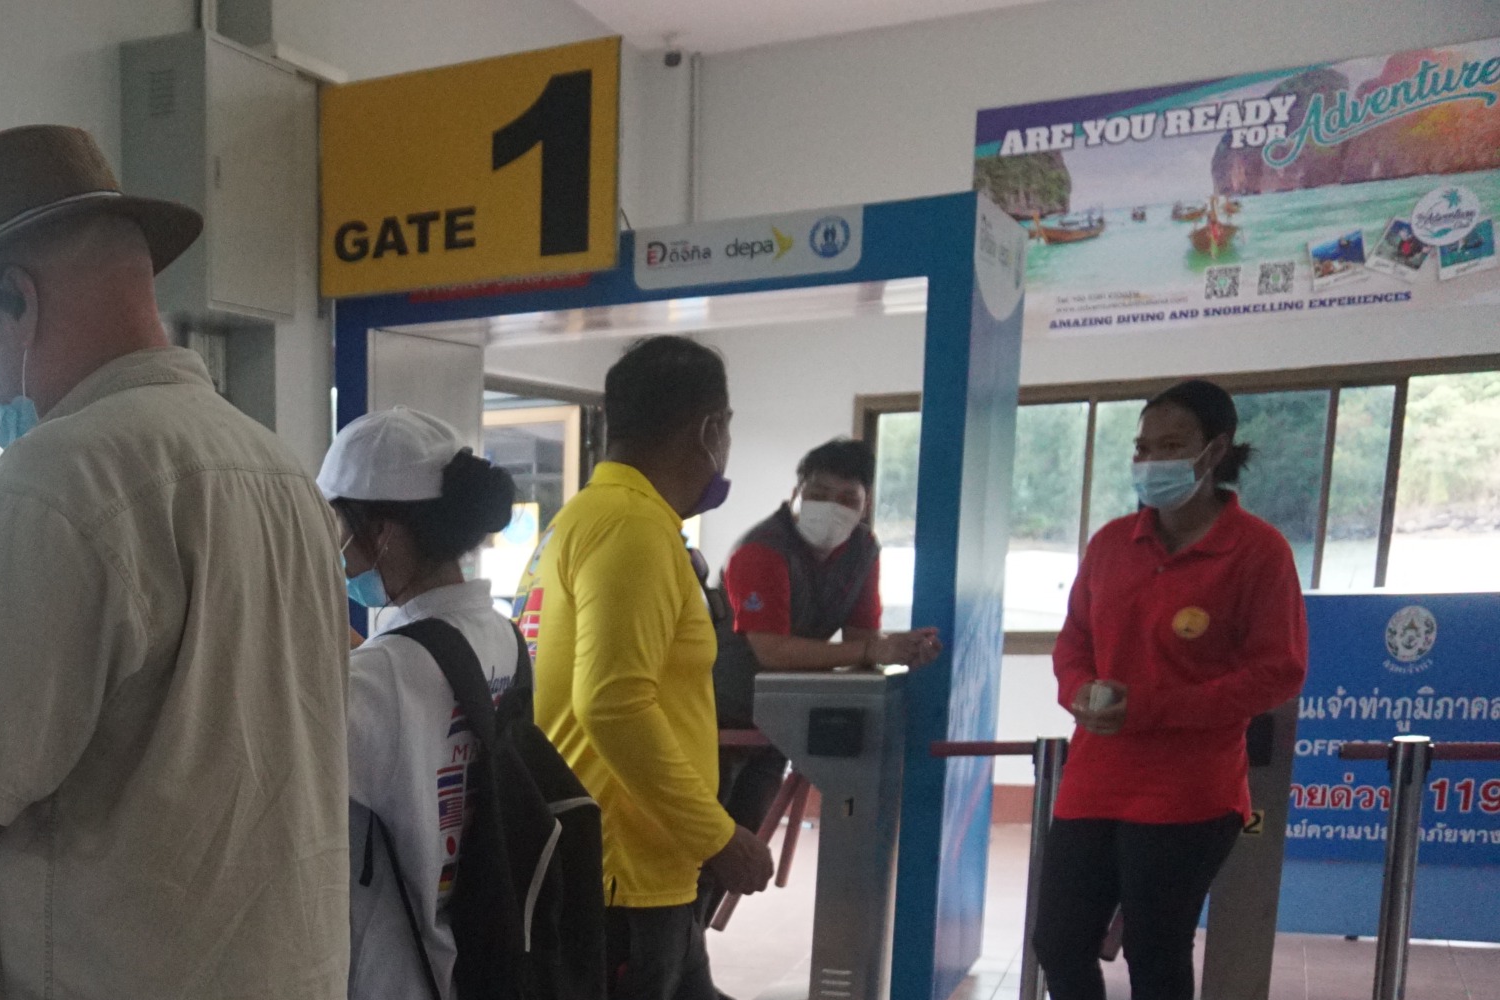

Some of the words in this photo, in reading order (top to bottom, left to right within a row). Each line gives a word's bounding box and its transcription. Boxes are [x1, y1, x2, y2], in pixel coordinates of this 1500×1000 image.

[1000, 123, 1075, 154] ARE
[1082, 114, 1156, 146] YOU
[1164, 95, 1297, 136] READY
[1263, 56, 1500, 168] Adventure
[1230, 124, 1287, 149] FOR
[492, 69, 591, 256] 1
[334, 206, 476, 263] GATE
[725, 237, 774, 260] depa
[1049, 316, 1113, 330] AMAZING
[1116, 311, 1165, 325] DIVING
[1169, 308, 1199, 321] AND
[1202, 300, 1304, 318] SNORKELLING
[1308, 290, 1412, 310] EXPERIENCES
[1243, 812, 1261, 834] 2
